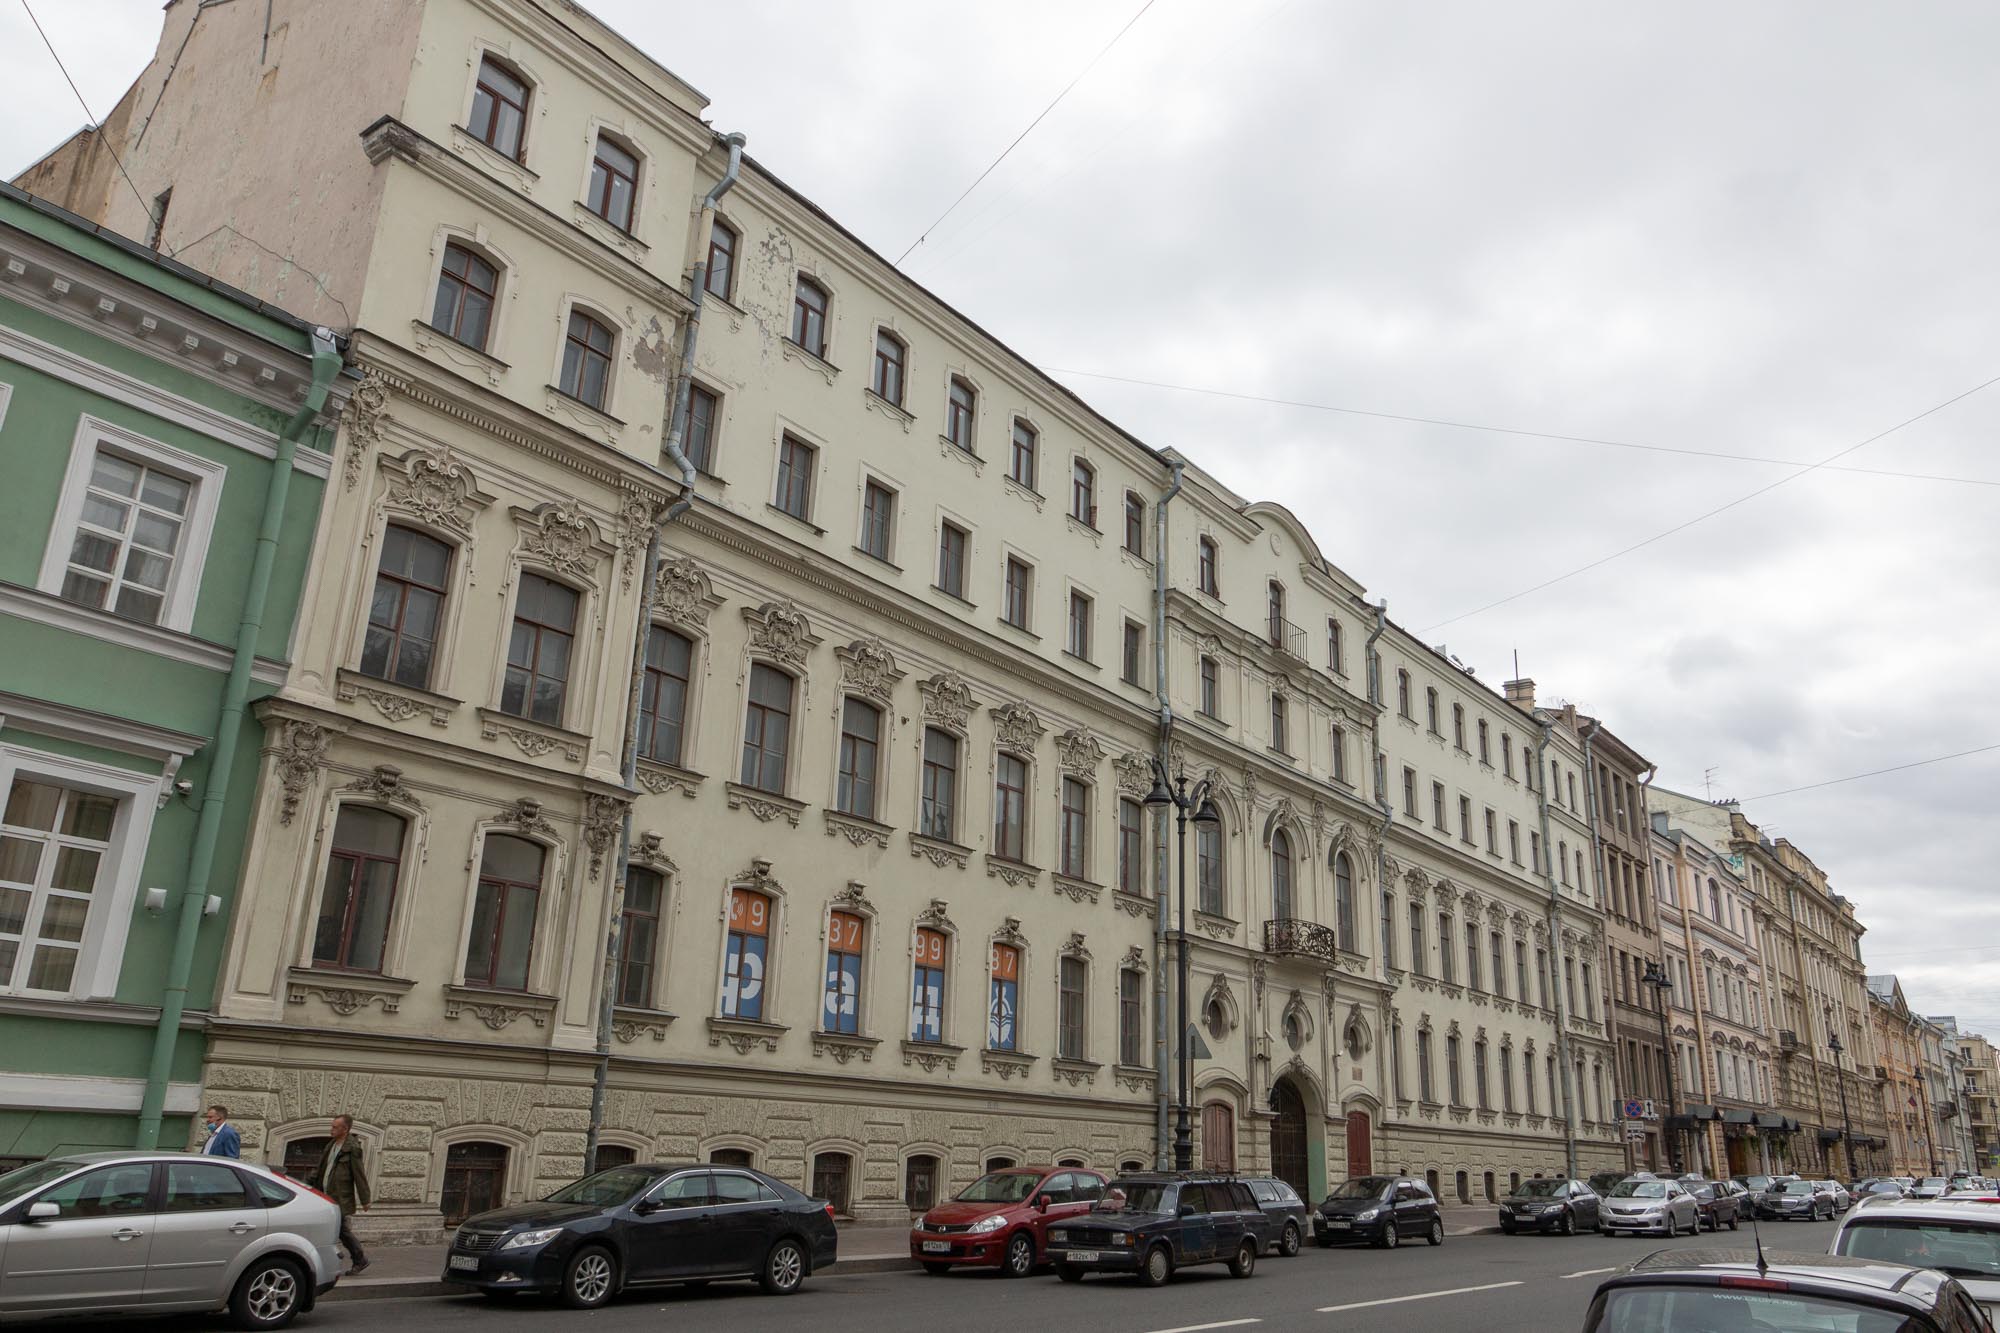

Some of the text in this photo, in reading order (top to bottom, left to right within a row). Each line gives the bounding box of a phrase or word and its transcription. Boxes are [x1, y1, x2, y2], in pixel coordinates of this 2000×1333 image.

[751, 900, 765, 927] 9
[830, 918, 859, 945] 37
[916, 934, 941, 961] 99
